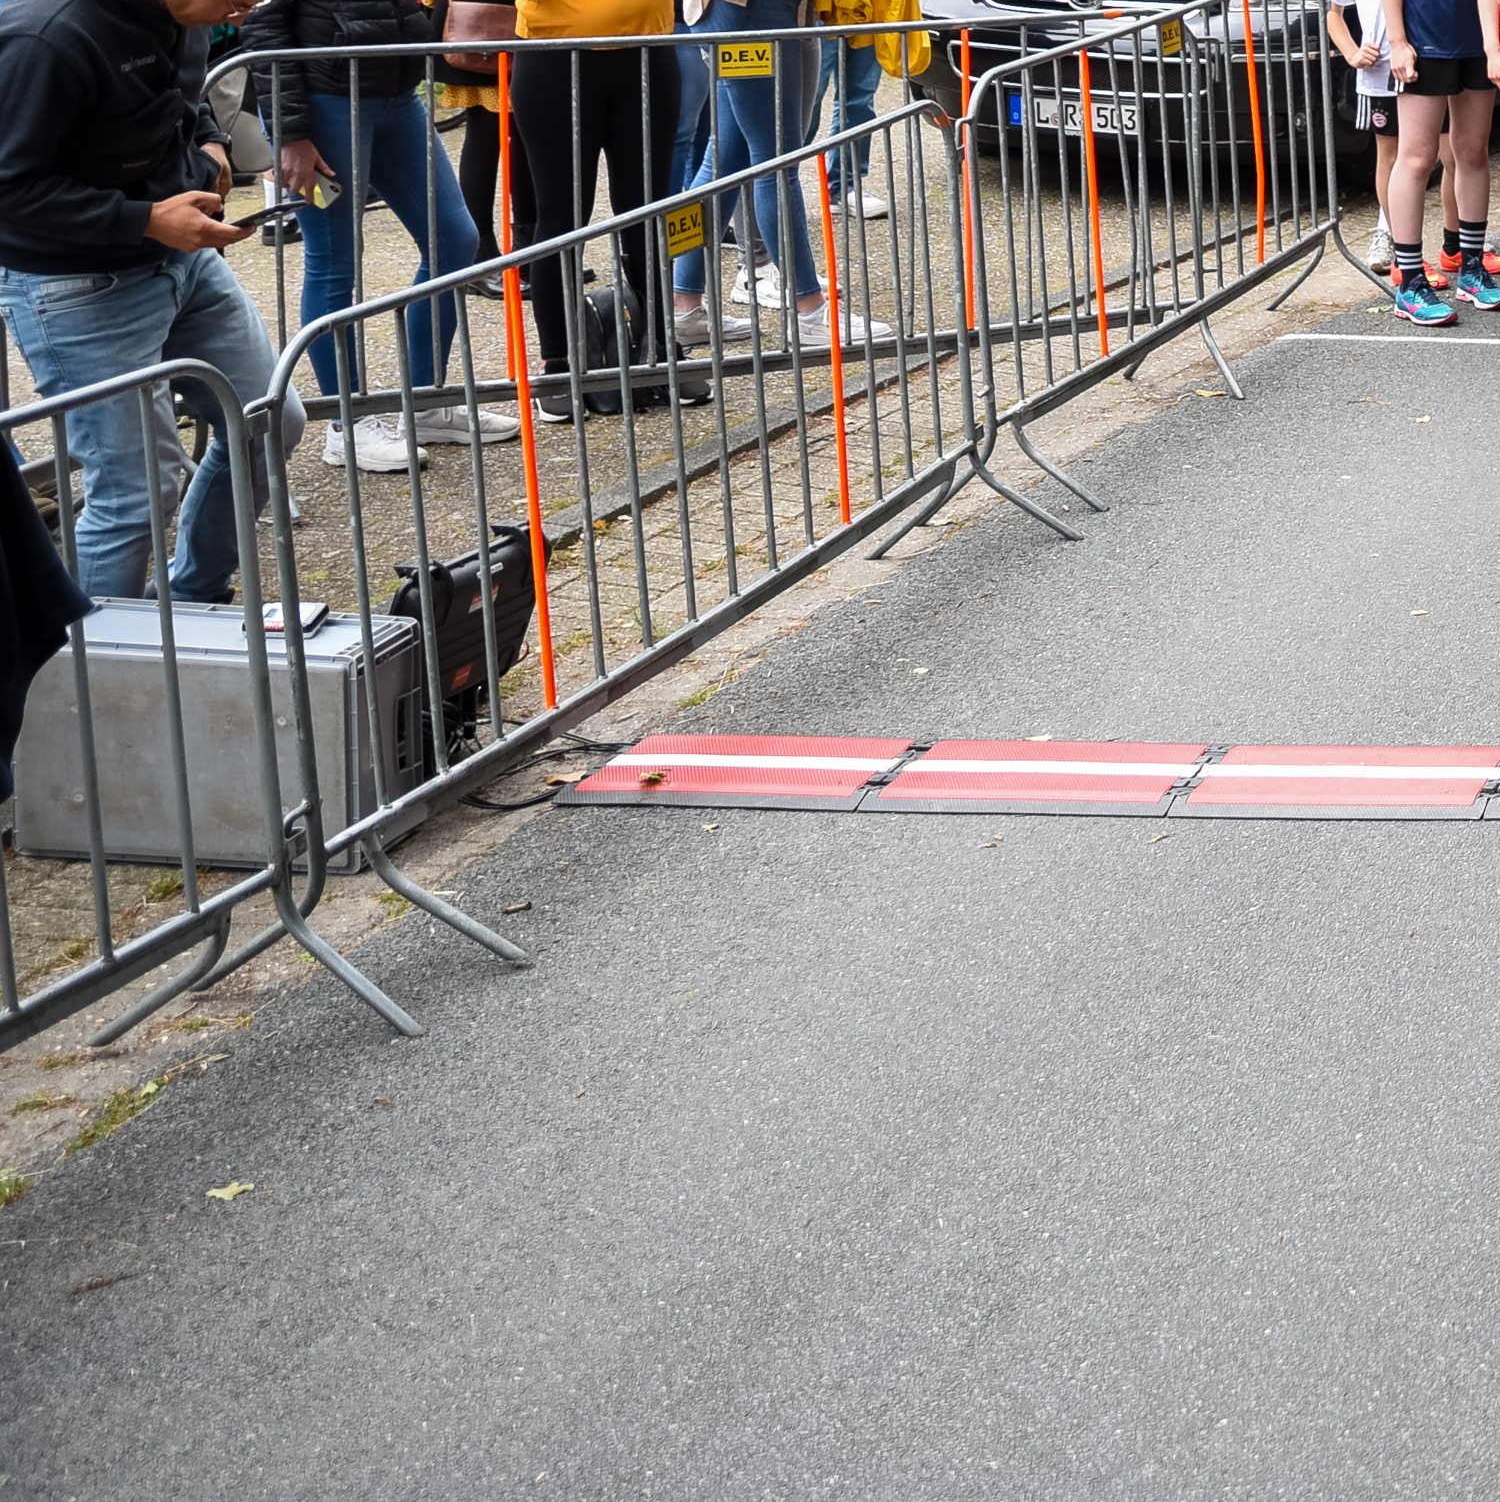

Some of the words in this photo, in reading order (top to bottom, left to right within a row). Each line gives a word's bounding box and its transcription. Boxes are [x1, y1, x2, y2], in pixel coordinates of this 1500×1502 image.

[721, 49, 770, 63] D.E.V.
[1036, 101, 1049, 124] L
[668, 212, 701, 238] D.E.V.
